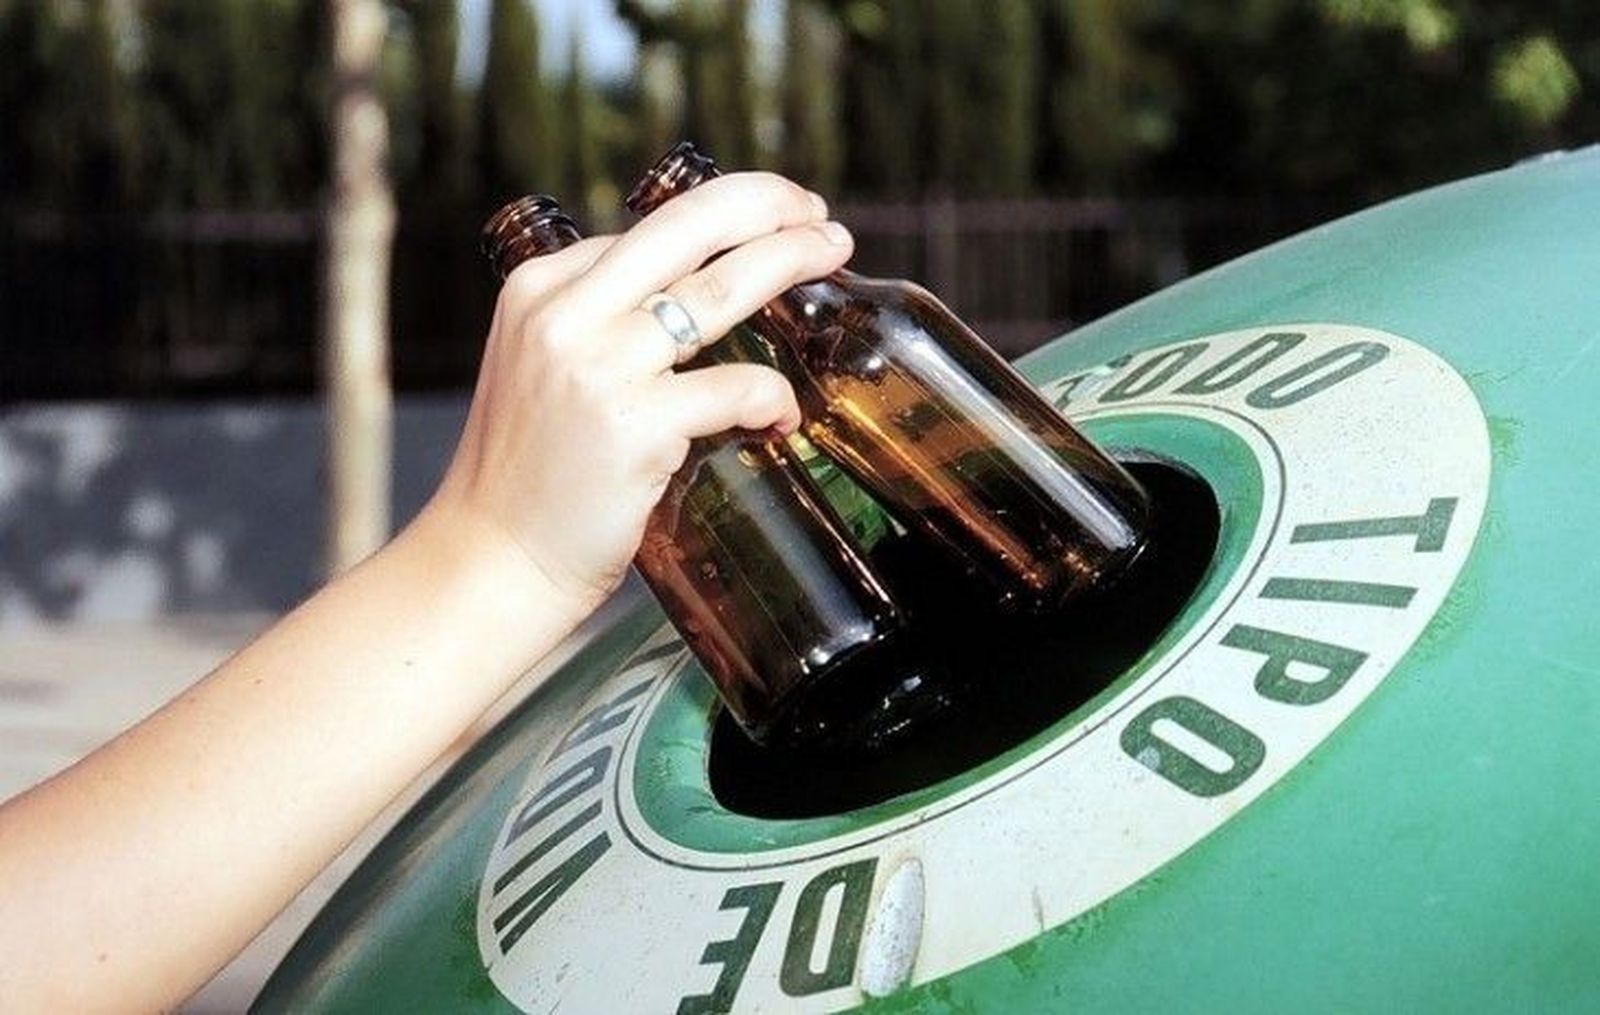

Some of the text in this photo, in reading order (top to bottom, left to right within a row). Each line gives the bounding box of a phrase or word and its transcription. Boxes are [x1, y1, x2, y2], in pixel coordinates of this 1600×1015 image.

[493, 639, 687, 956] VIDRI
[1119, 496, 1459, 798] TIPO
[675, 857, 879, 1015] DE
